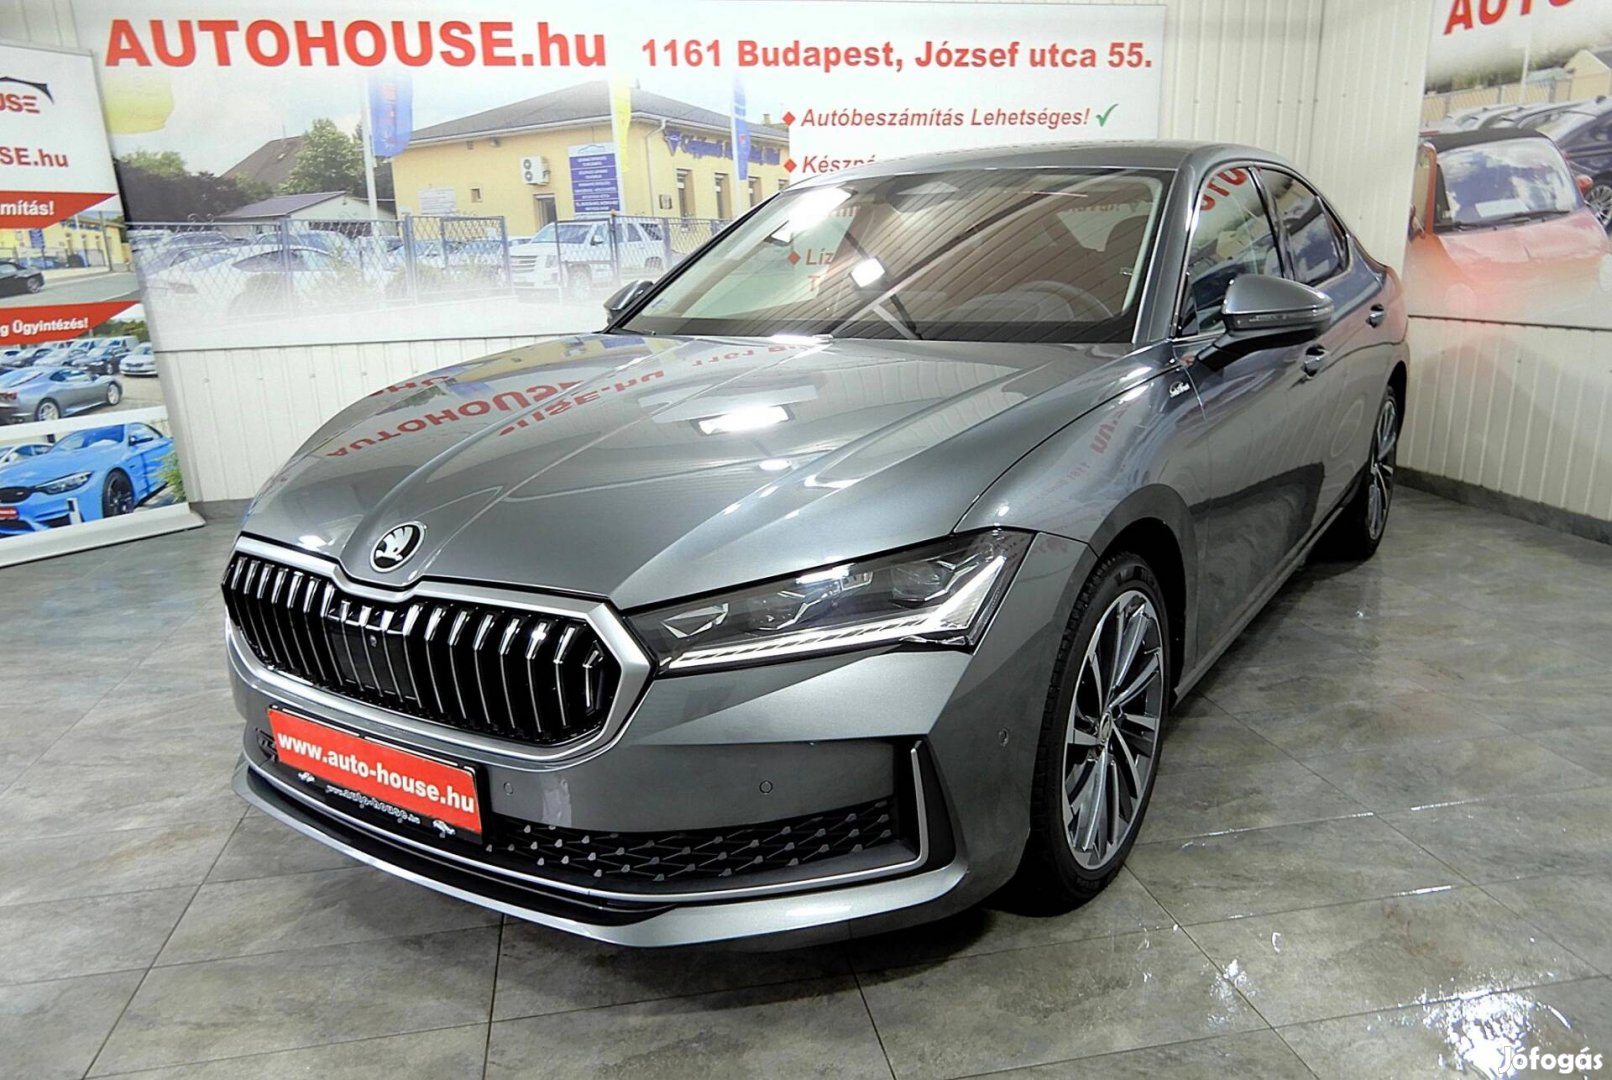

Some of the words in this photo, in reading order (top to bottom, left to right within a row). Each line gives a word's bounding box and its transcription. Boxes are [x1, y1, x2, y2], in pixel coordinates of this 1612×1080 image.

[105, 19, 606, 67] AUTOHOUSE.hu
[642, 39, 721, 66] 1161
[737, 40, 904, 73] Budapest,
[915, 40, 1020, 67] József
[1029, 42, 1096, 67] utca
[1107, 42, 1152, 67] 55.
[801, 108, 963, 127] Autóbeszámítás
[971, 108, 1090, 129] Lehetséges!
[278, 732, 475, 814] www.auto-house.hu
